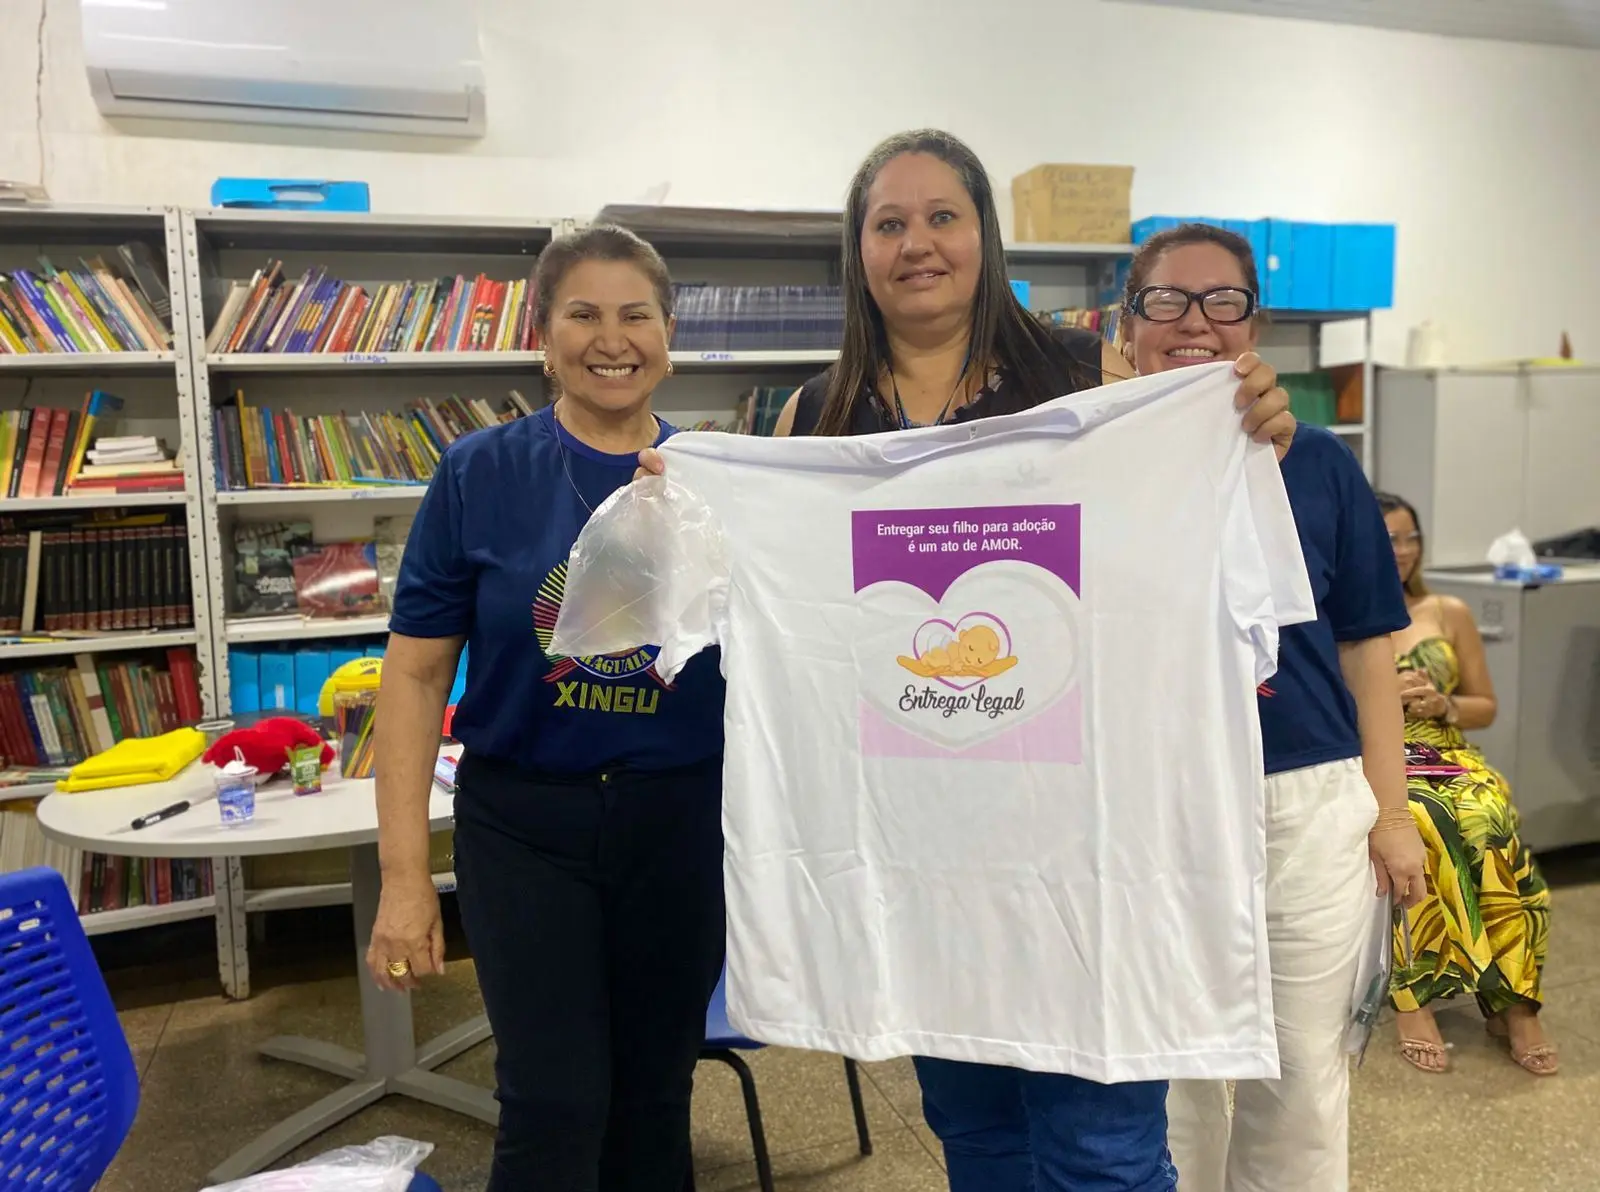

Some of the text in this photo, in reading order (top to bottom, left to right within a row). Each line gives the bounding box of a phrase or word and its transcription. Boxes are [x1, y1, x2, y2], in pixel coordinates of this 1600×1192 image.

[877, 518, 1056, 538] Entregar seu filho para adoção
[908, 538, 1023, 553] é um ato de AMOR.
[553, 681, 659, 713] XINGU
[899, 684, 1025, 719] Entrega Legal
